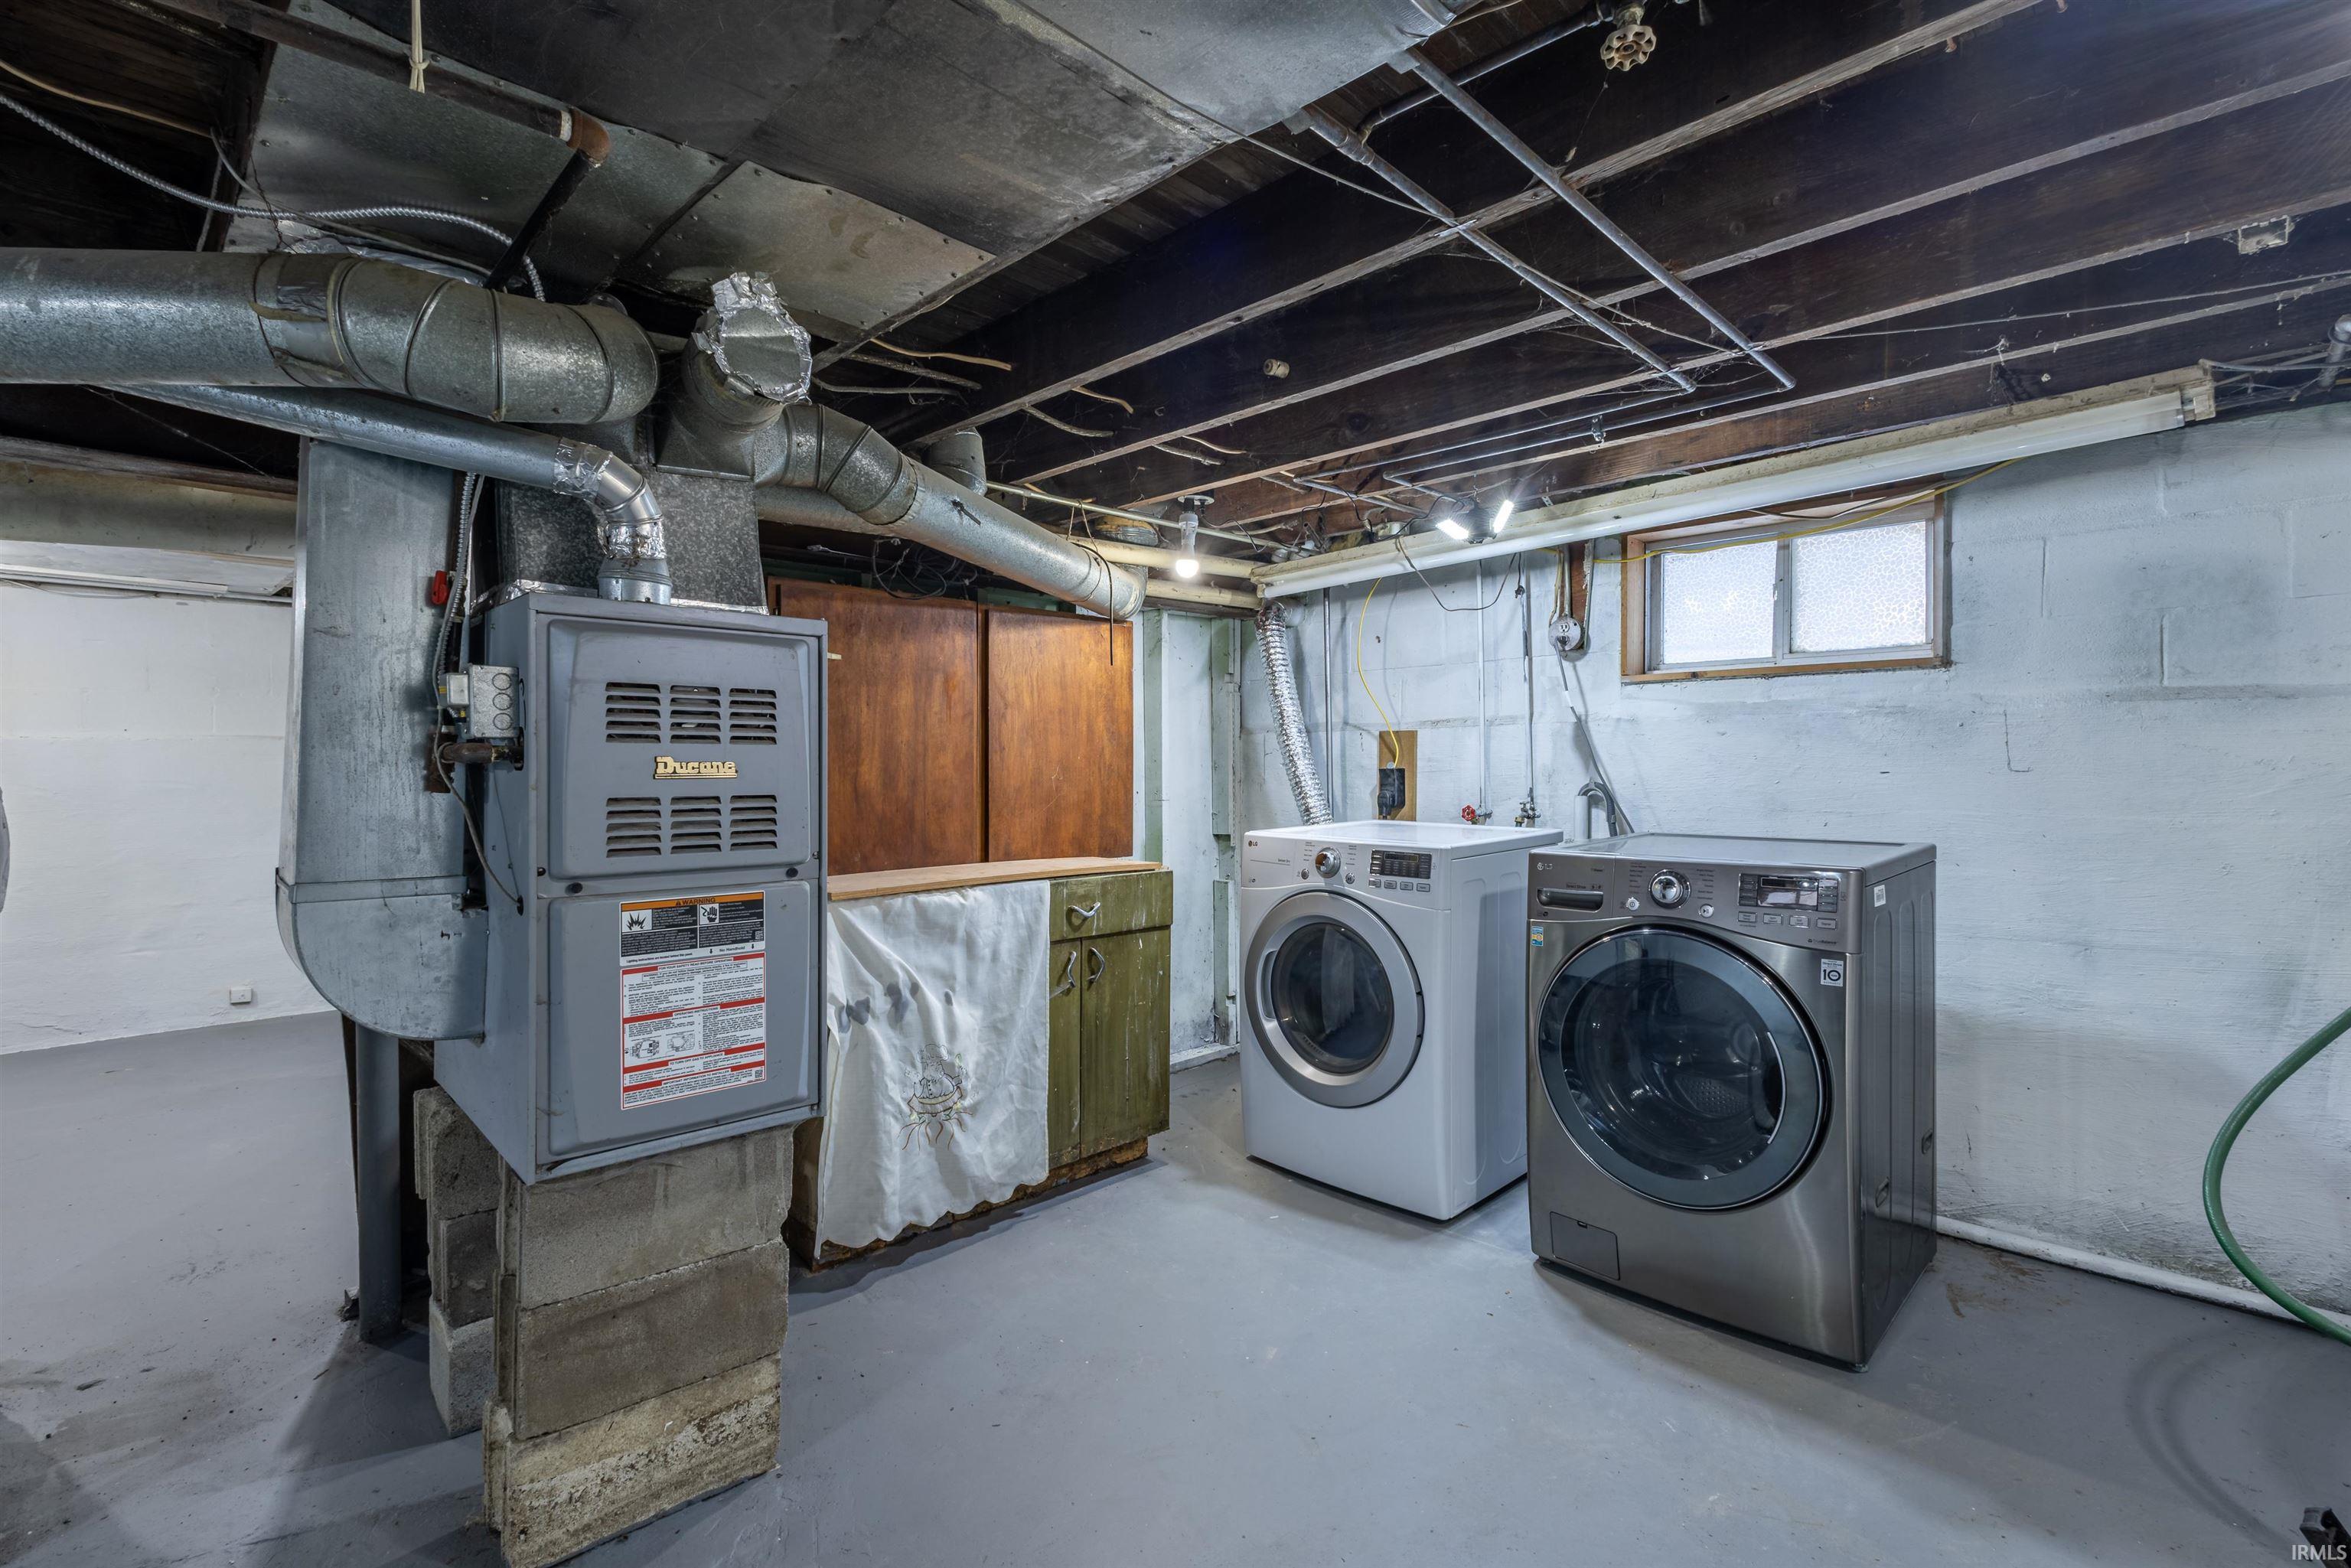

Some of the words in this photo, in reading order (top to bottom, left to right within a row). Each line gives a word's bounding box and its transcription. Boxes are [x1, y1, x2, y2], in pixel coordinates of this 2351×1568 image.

[656, 756, 736, 774] Ducane
[682, 897, 716, 905] WARNING
[1822, 969, 1841, 981] 10
